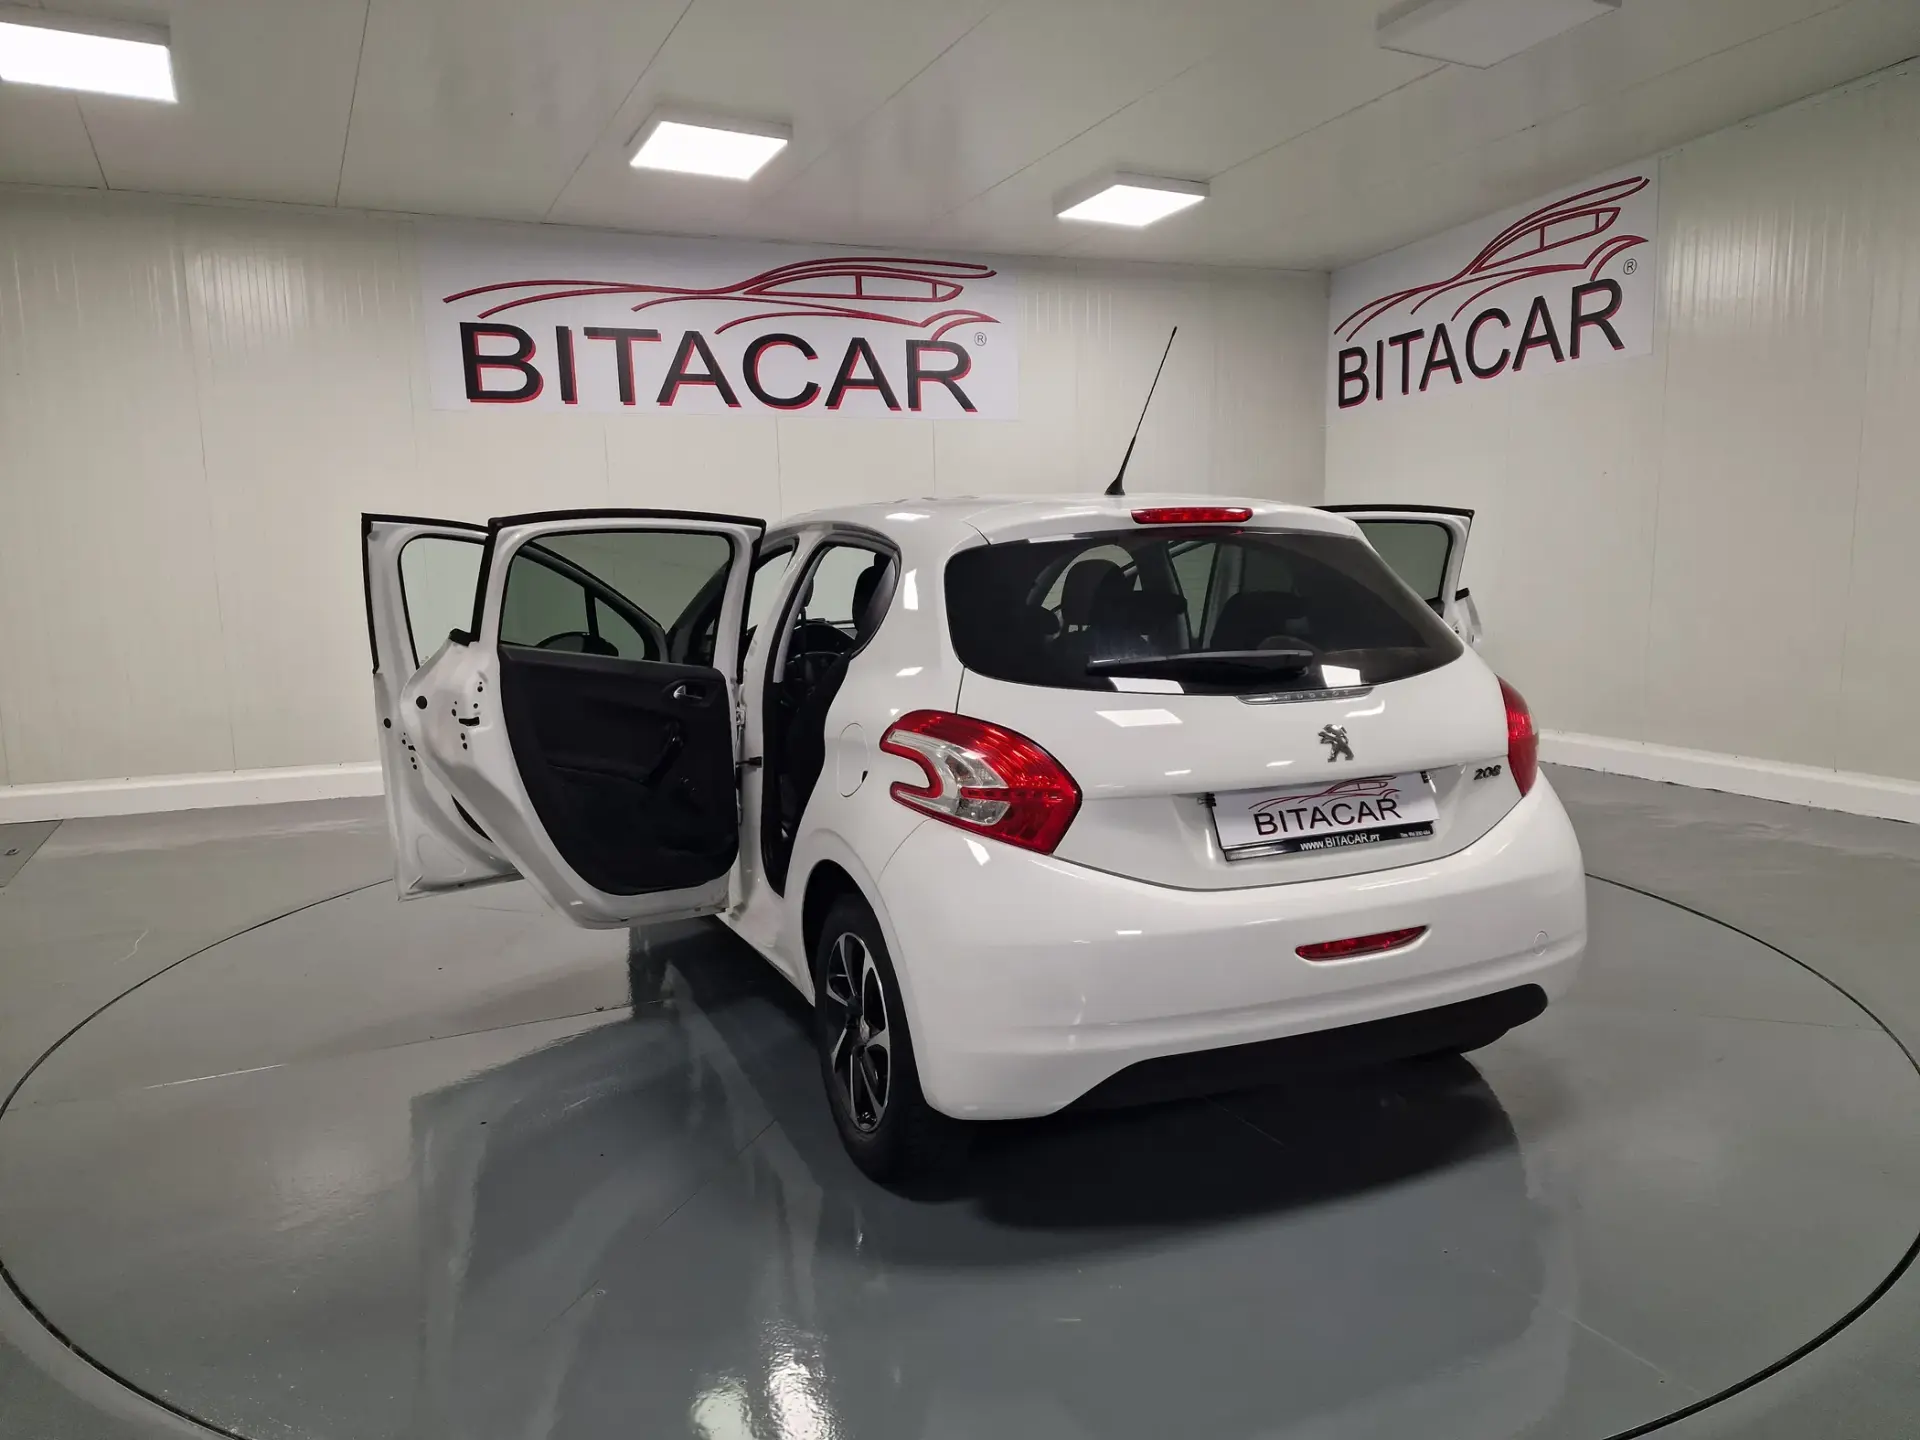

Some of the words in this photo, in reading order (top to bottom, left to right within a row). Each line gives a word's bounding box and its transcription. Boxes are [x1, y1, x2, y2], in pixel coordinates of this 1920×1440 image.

[459, 321, 978, 412] BITACAR
[1338, 278, 1625, 409] BITACAR
[1473, 764, 1502, 780] 208
[1254, 799, 1402, 836] BITACAR
